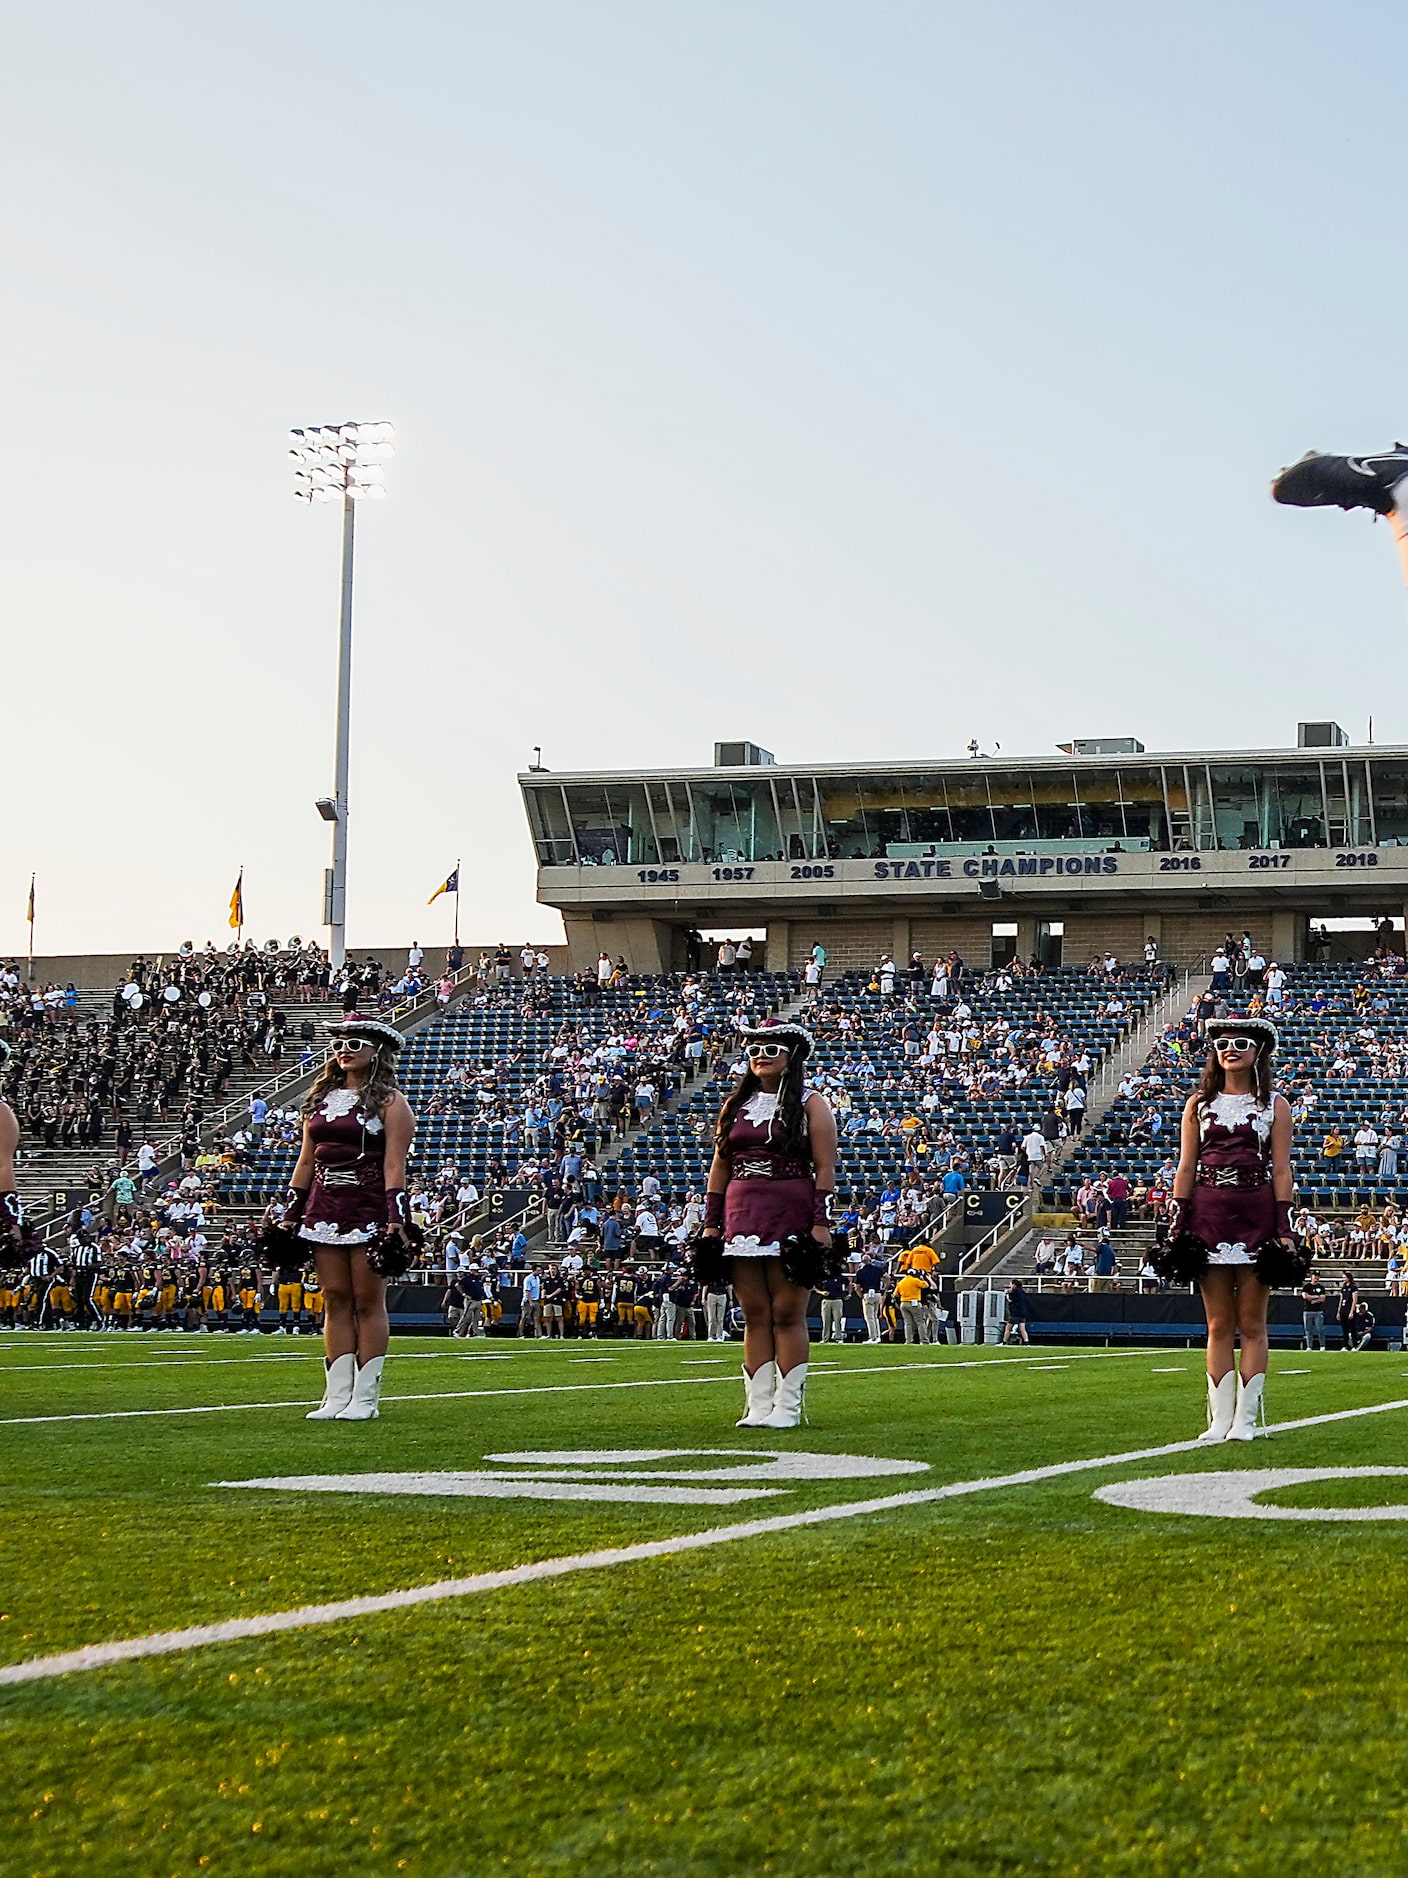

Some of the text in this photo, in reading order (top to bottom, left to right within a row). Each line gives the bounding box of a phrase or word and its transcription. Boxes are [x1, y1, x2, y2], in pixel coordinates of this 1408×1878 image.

[637, 852, 1378, 884] 1945 1957 2005 STATE CHAMPIONS 2016 2017 2018
[55, 1192, 67, 1205] B
[491, 1193, 504, 1206] C
[967, 1194, 980, 1208] C
[1005, 1194, 1019, 1208] C
